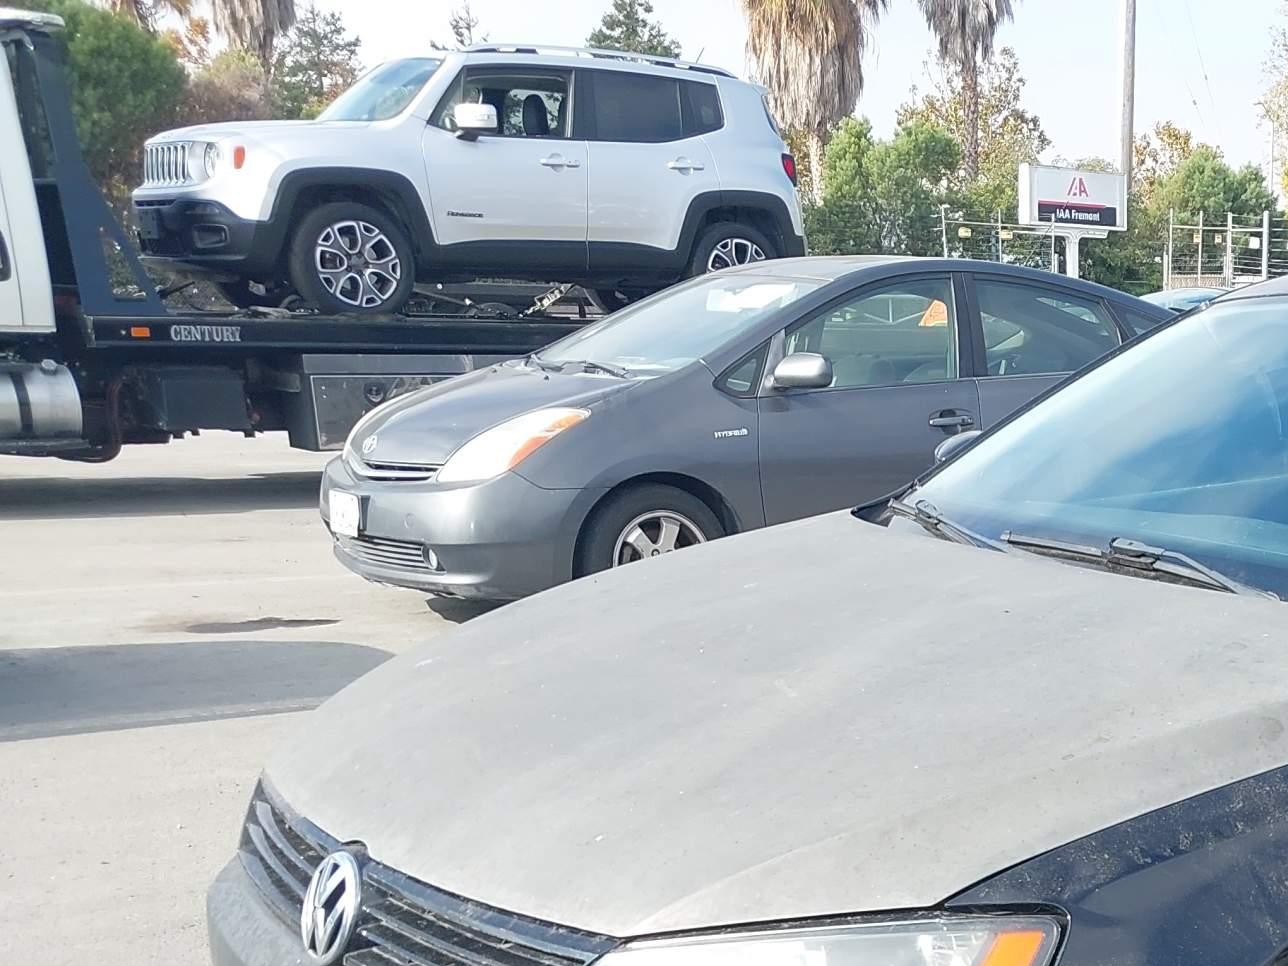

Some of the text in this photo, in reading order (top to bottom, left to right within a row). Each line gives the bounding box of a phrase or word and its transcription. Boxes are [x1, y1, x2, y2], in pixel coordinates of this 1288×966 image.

[1056, 208, 1100, 221] IAA Fremont
[170, 325, 241, 342] CENTURY
